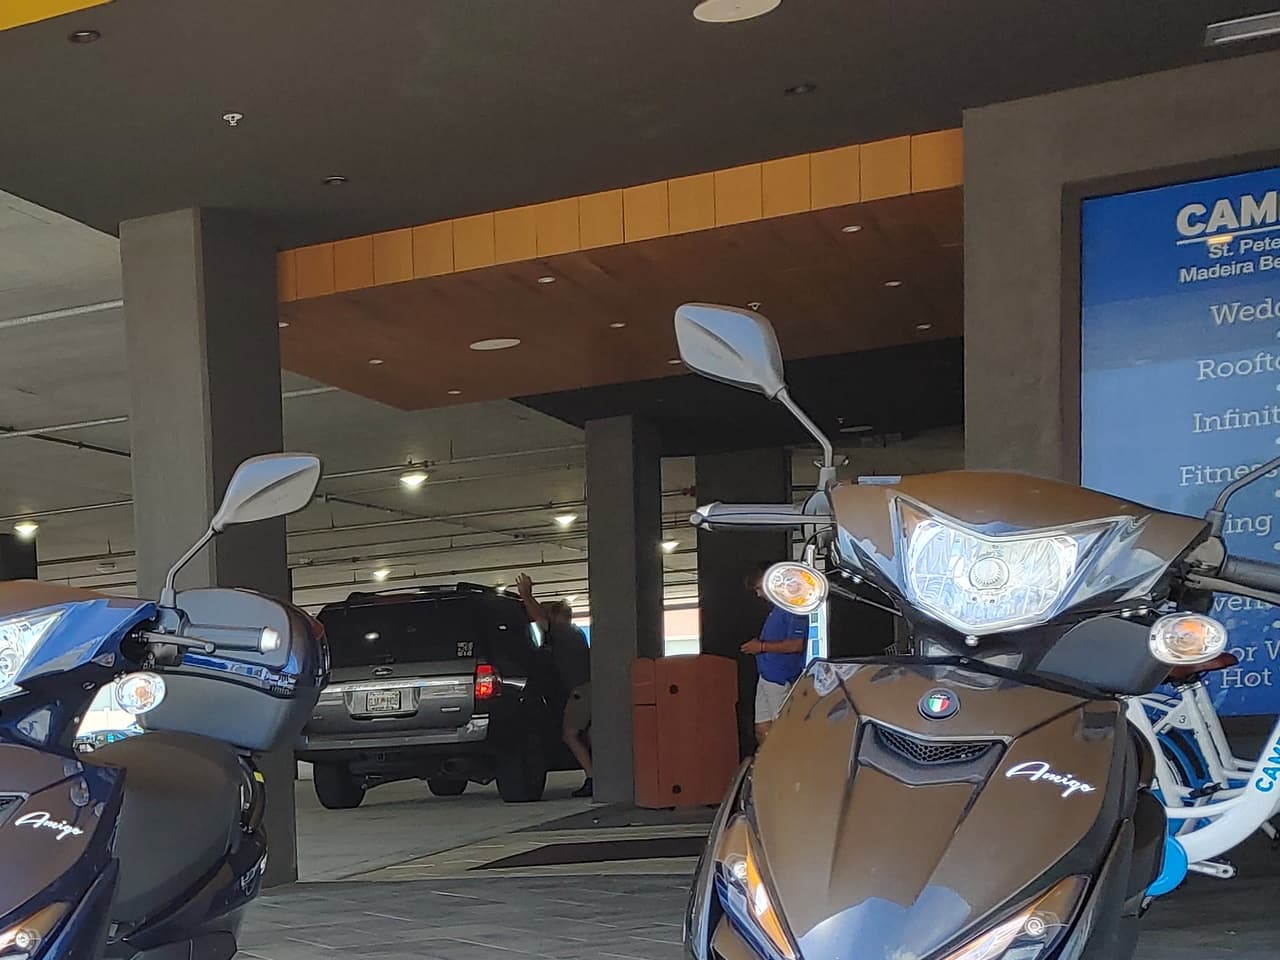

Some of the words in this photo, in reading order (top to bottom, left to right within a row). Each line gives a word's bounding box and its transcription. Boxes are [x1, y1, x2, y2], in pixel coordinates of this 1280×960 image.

[1176, 191, 1280, 236] CAM
[1208, 244, 1234, 258] St.
[1179, 261, 1254, 283] Madeira
[1224, 513, 1273, 536] ing
[1220, 667, 1273, 689] Hot
[1005, 761, 1097, 798] Amigo
[14, 811, 84, 841] Amigo
